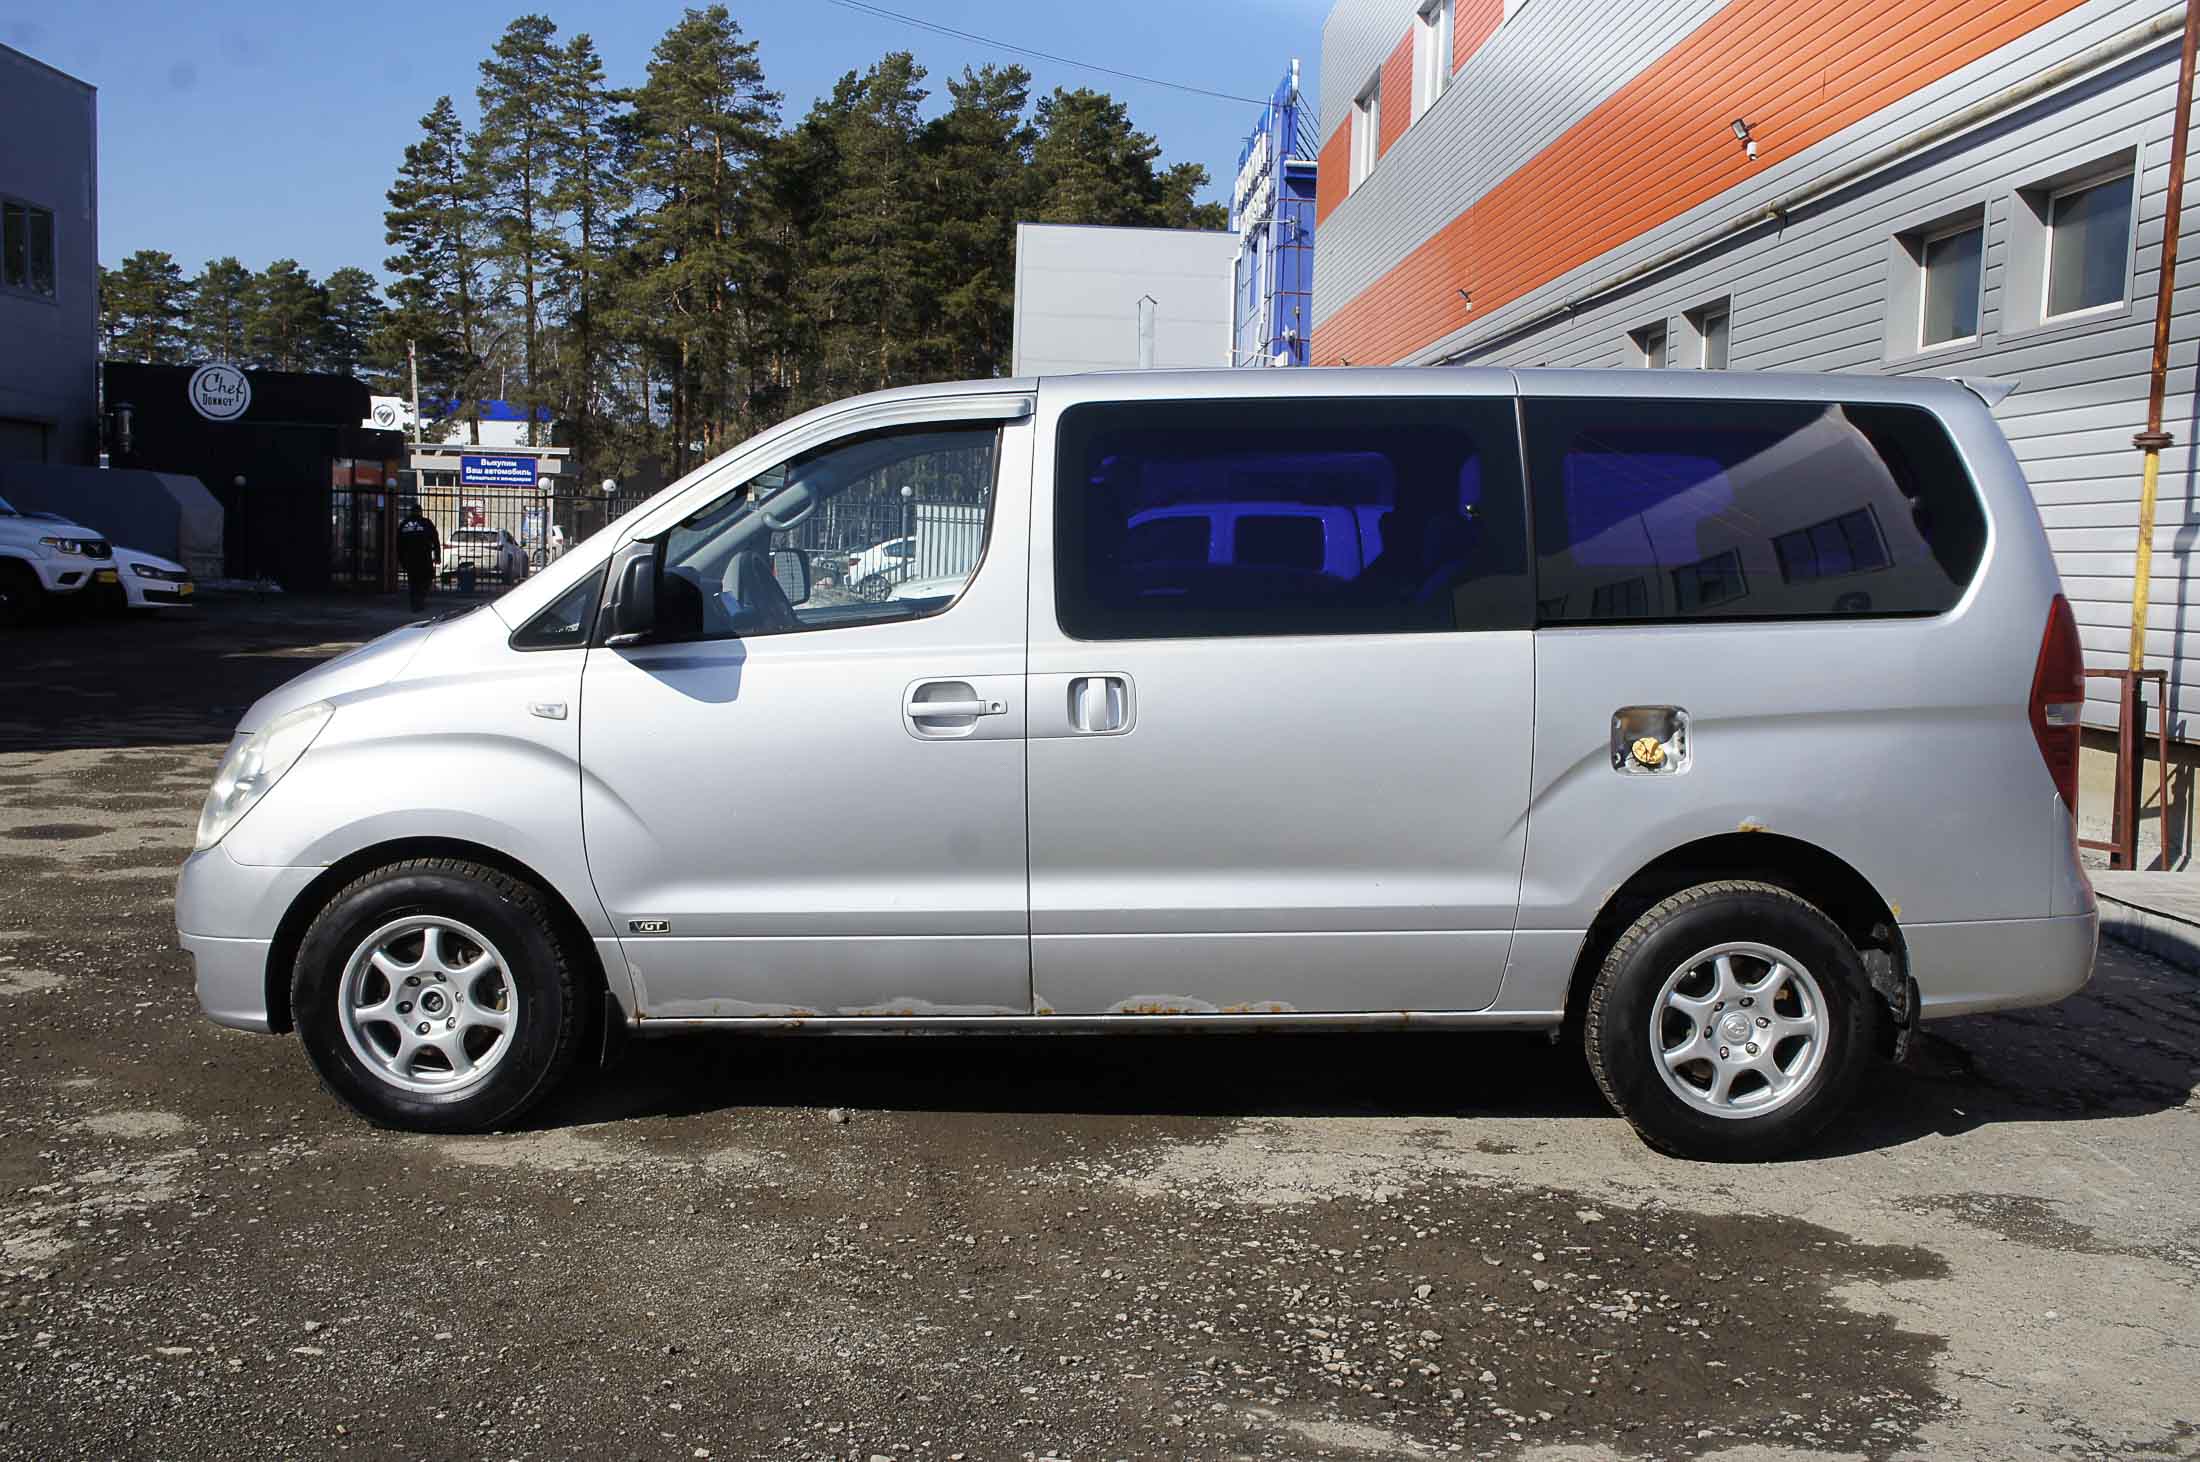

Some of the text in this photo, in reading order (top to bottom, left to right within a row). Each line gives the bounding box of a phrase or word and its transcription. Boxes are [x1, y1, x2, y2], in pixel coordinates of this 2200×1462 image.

[203, 373, 244, 402] Chef
[480, 458, 517, 468] Выкупим
[465, 466, 532, 476] Ваш автомобиль
[634, 921, 664, 931] VGT
